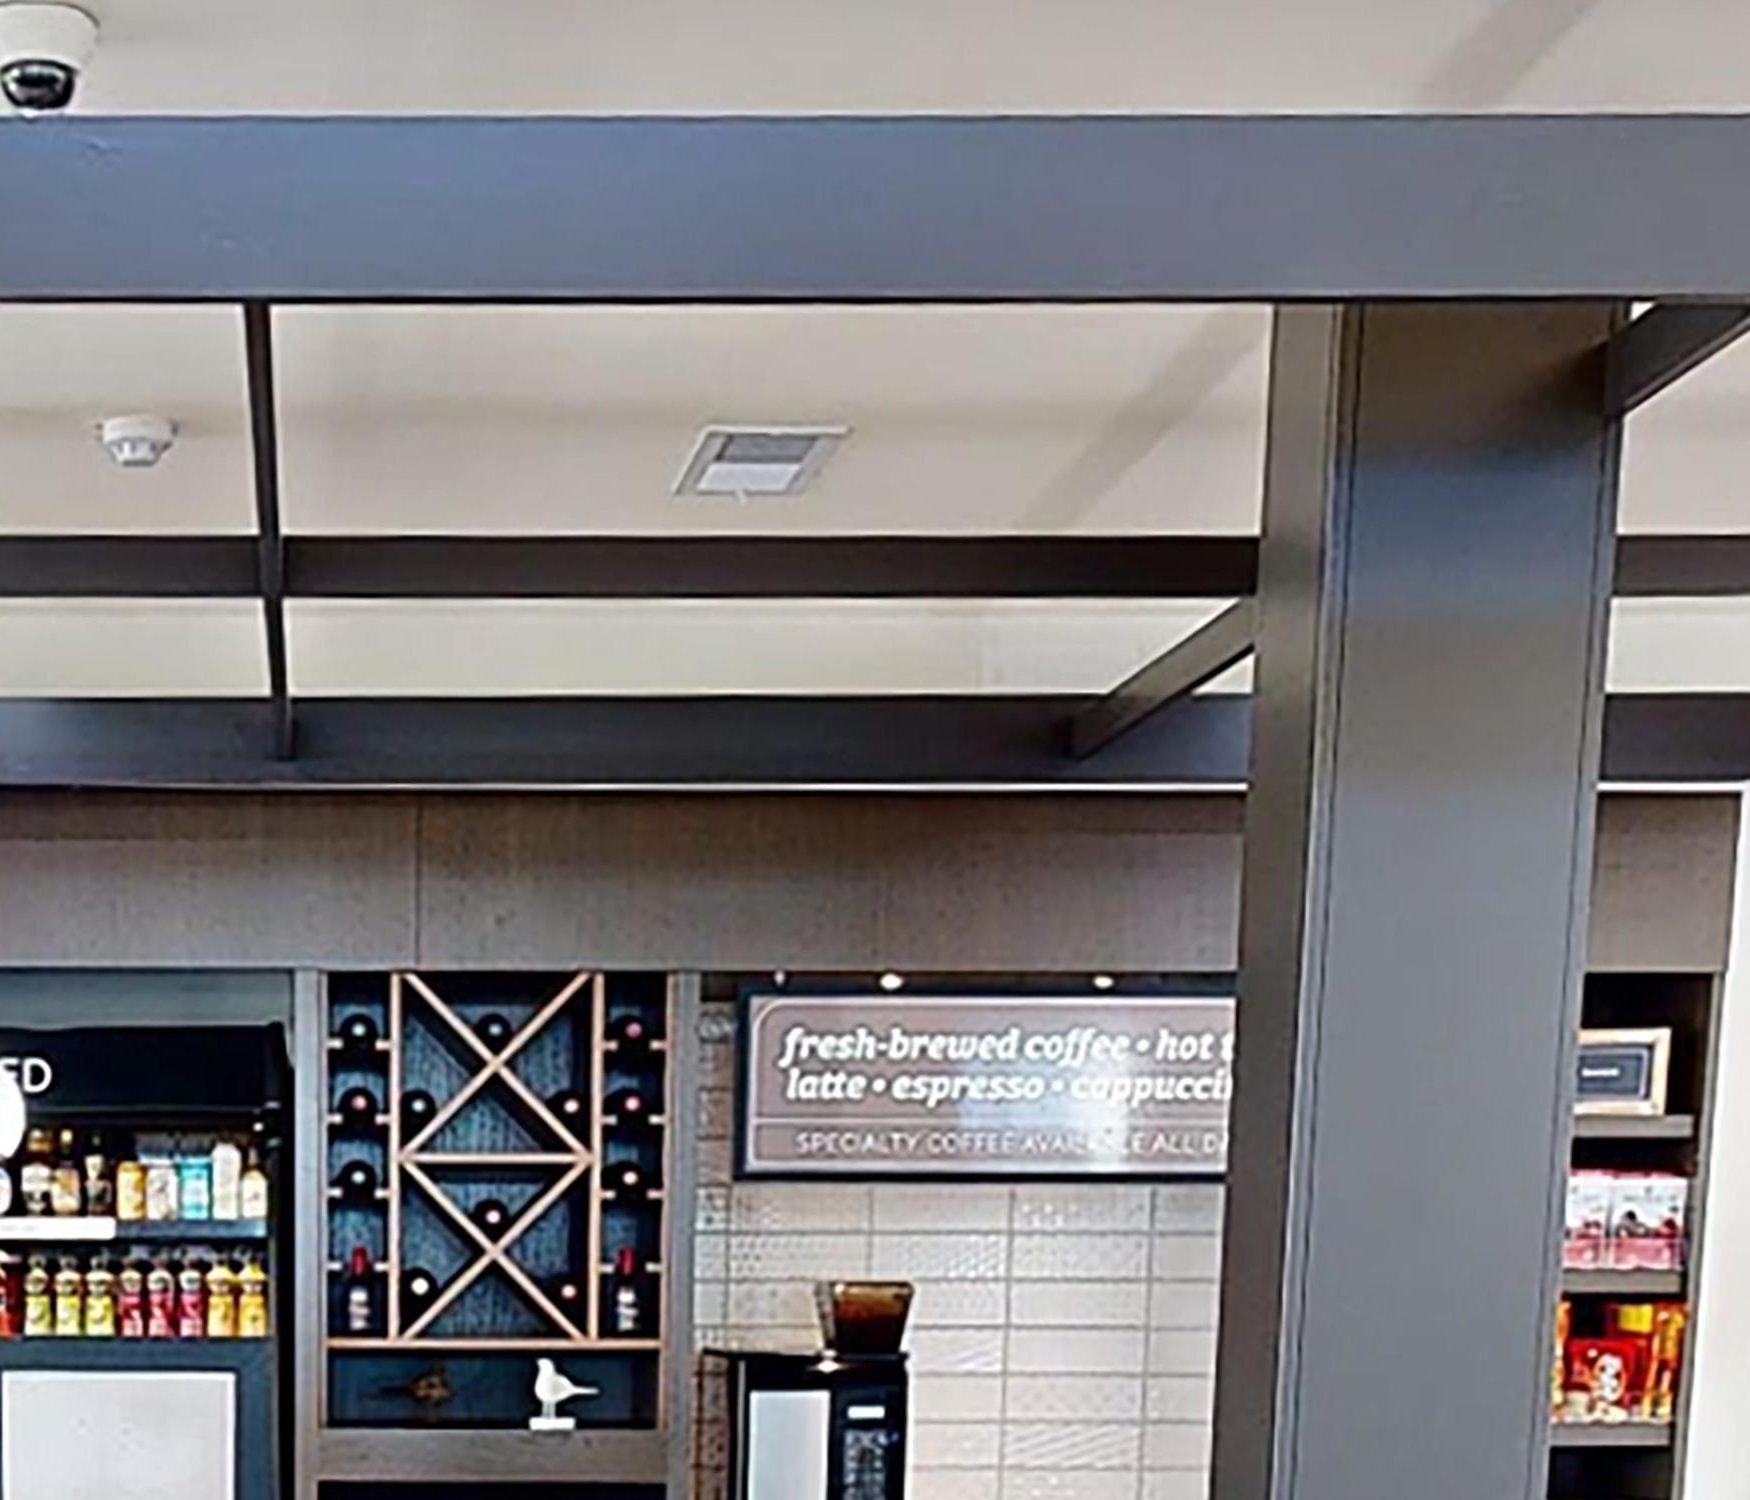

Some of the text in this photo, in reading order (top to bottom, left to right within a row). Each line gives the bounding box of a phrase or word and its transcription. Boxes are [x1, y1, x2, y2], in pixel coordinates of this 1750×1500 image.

[777, 1026, 1021, 1068] fresh-brewed
[1024, 1027, 1131, 1068] coffee
[1154, 1027, 1214, 1061] hot
[786, 1067, 867, 1099] latte
[891, 1073, 1046, 1109] espresso
[796, 1131, 923, 1154] SPECIALTY
[926, 1131, 1014, 1154] COFFEE
[1020, 1131, 1146, 1155] AVAILLE
[1151, 1131, 1201, 1154] ALL
